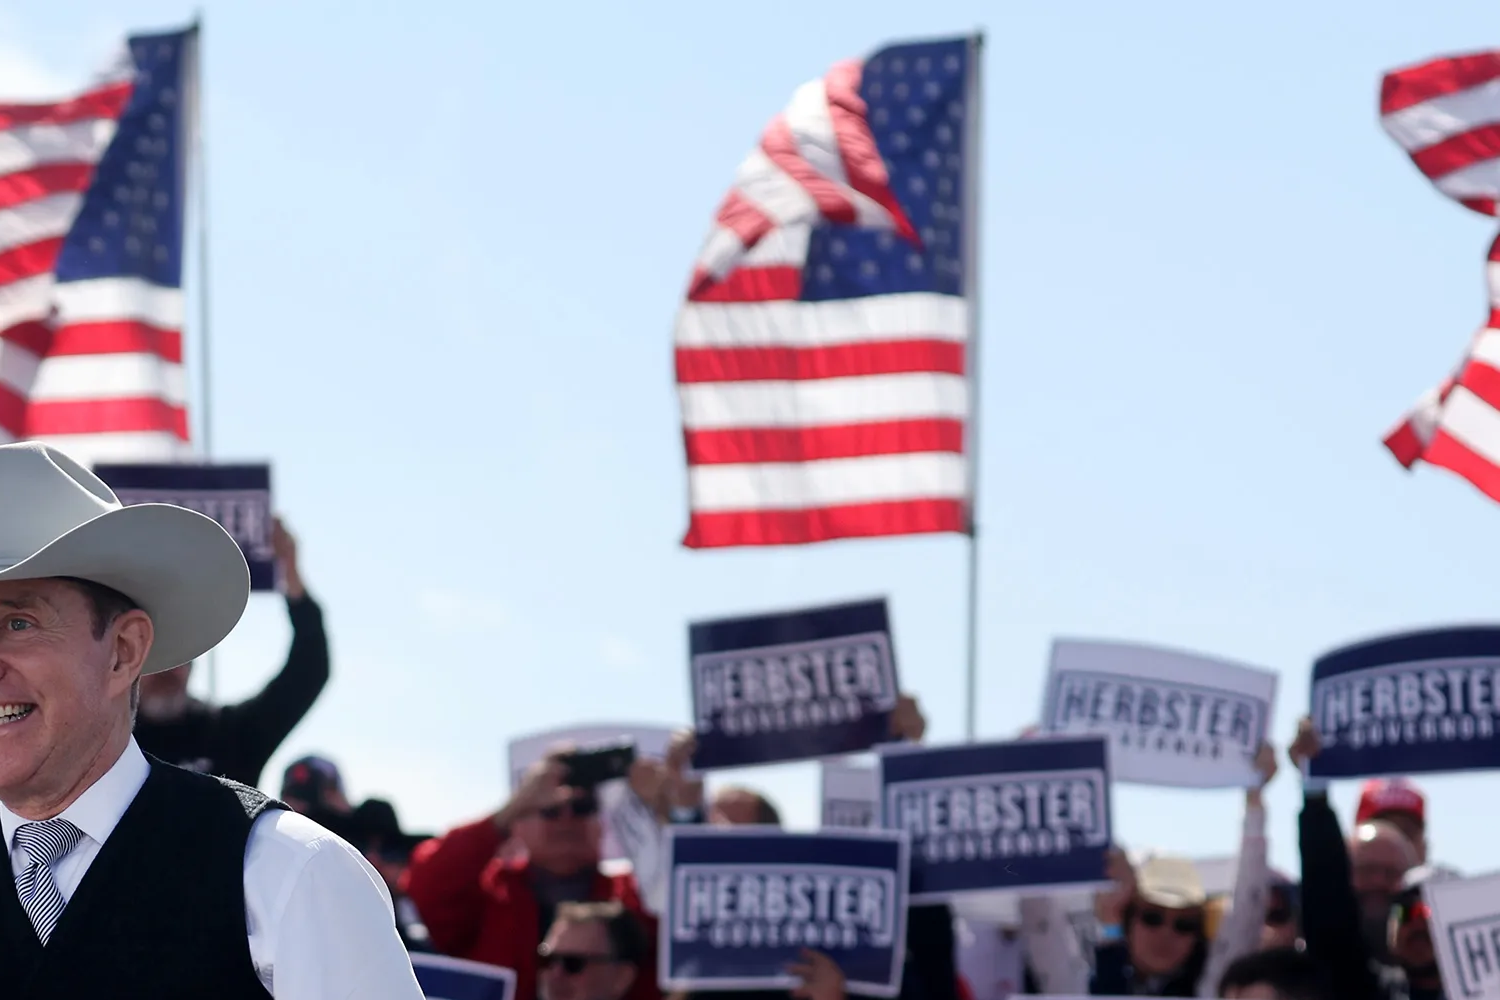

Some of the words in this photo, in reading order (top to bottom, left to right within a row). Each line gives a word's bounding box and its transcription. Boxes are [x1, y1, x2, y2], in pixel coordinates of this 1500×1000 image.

[703, 646, 882, 712] HERBSTER
[1327, 666, 1500, 731] HERBSTE
[1060, 677, 1254, 748] HERBSTER
[904, 780, 1093, 843] HERBSTER
[688, 873, 885, 929] HERBSTER
